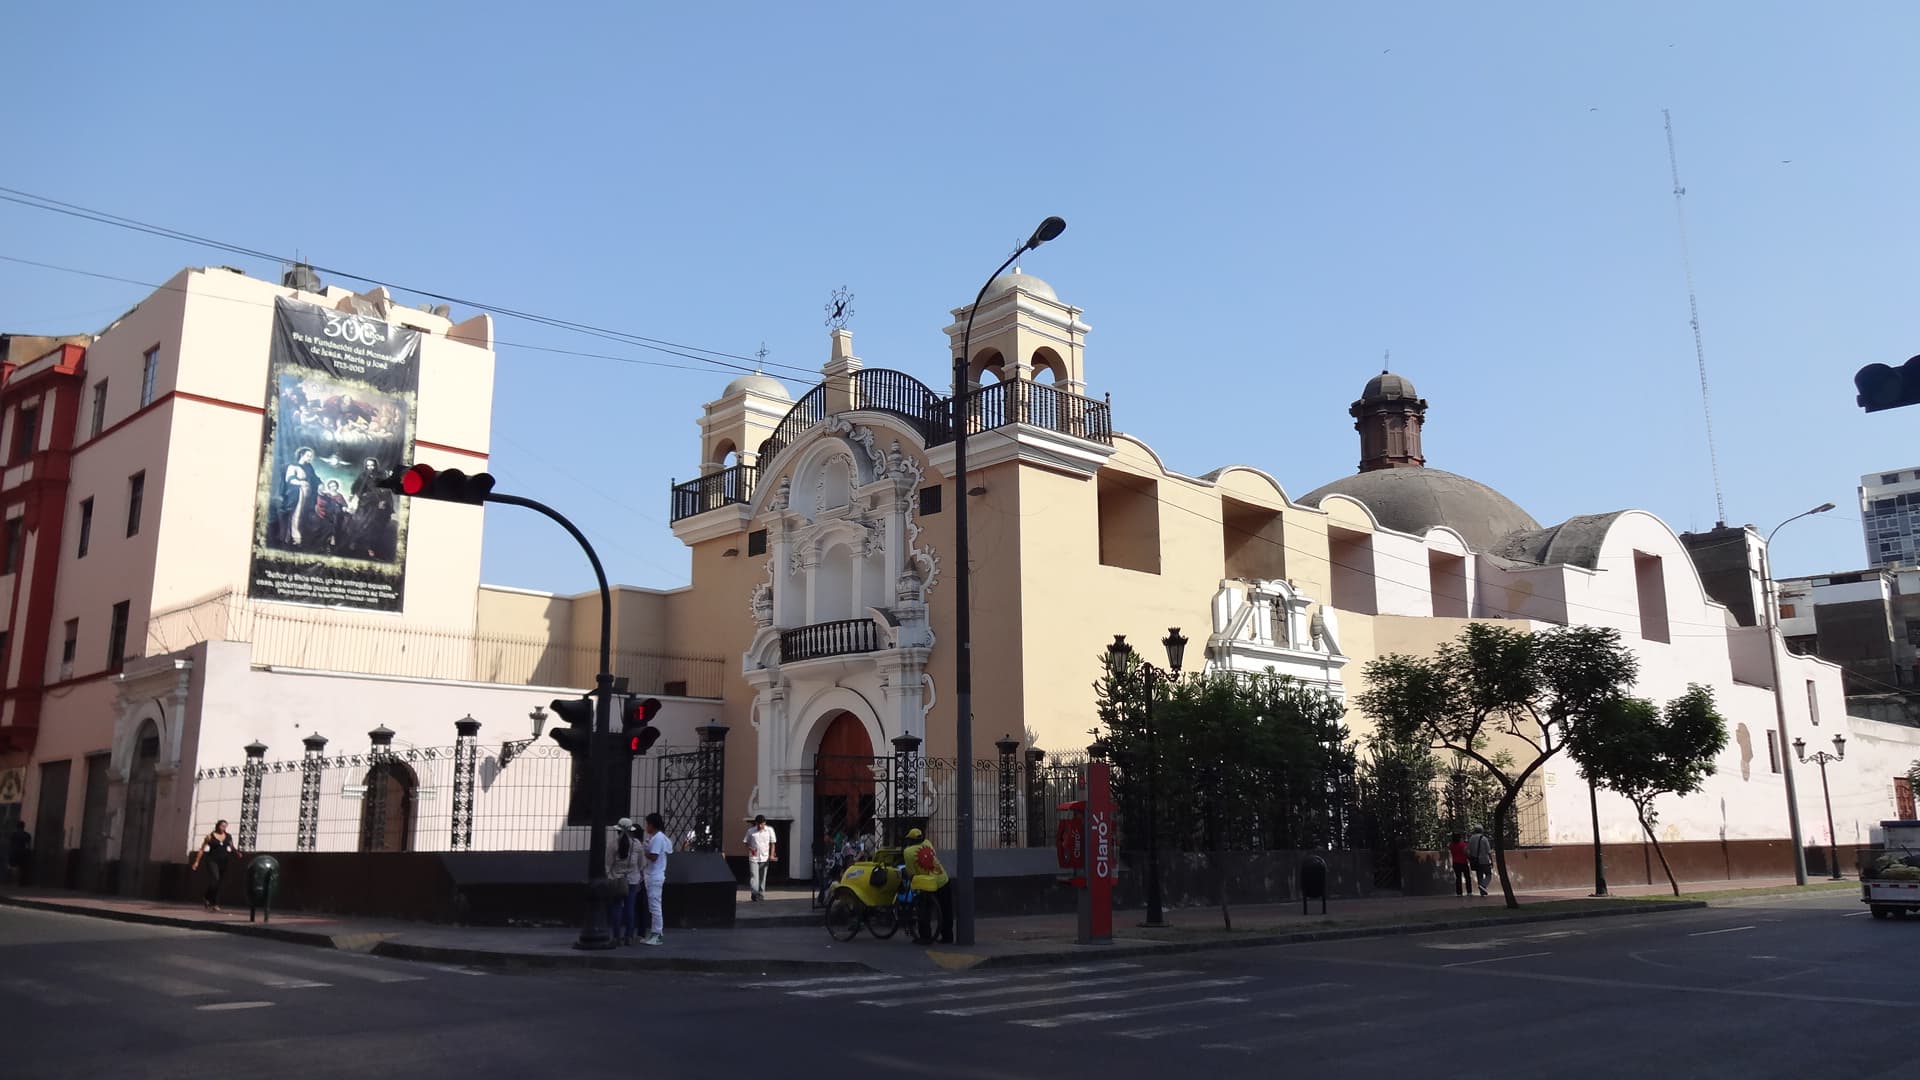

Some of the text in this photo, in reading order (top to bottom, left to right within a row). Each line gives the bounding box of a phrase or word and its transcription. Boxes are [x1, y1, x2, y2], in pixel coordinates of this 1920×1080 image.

[323, 315, 377, 346] 300
[304, 334, 313, 344] la
[353, 347, 365, 355] del
[310, 346, 321, 355] de
[1094, 815, 1108, 878] Claro
